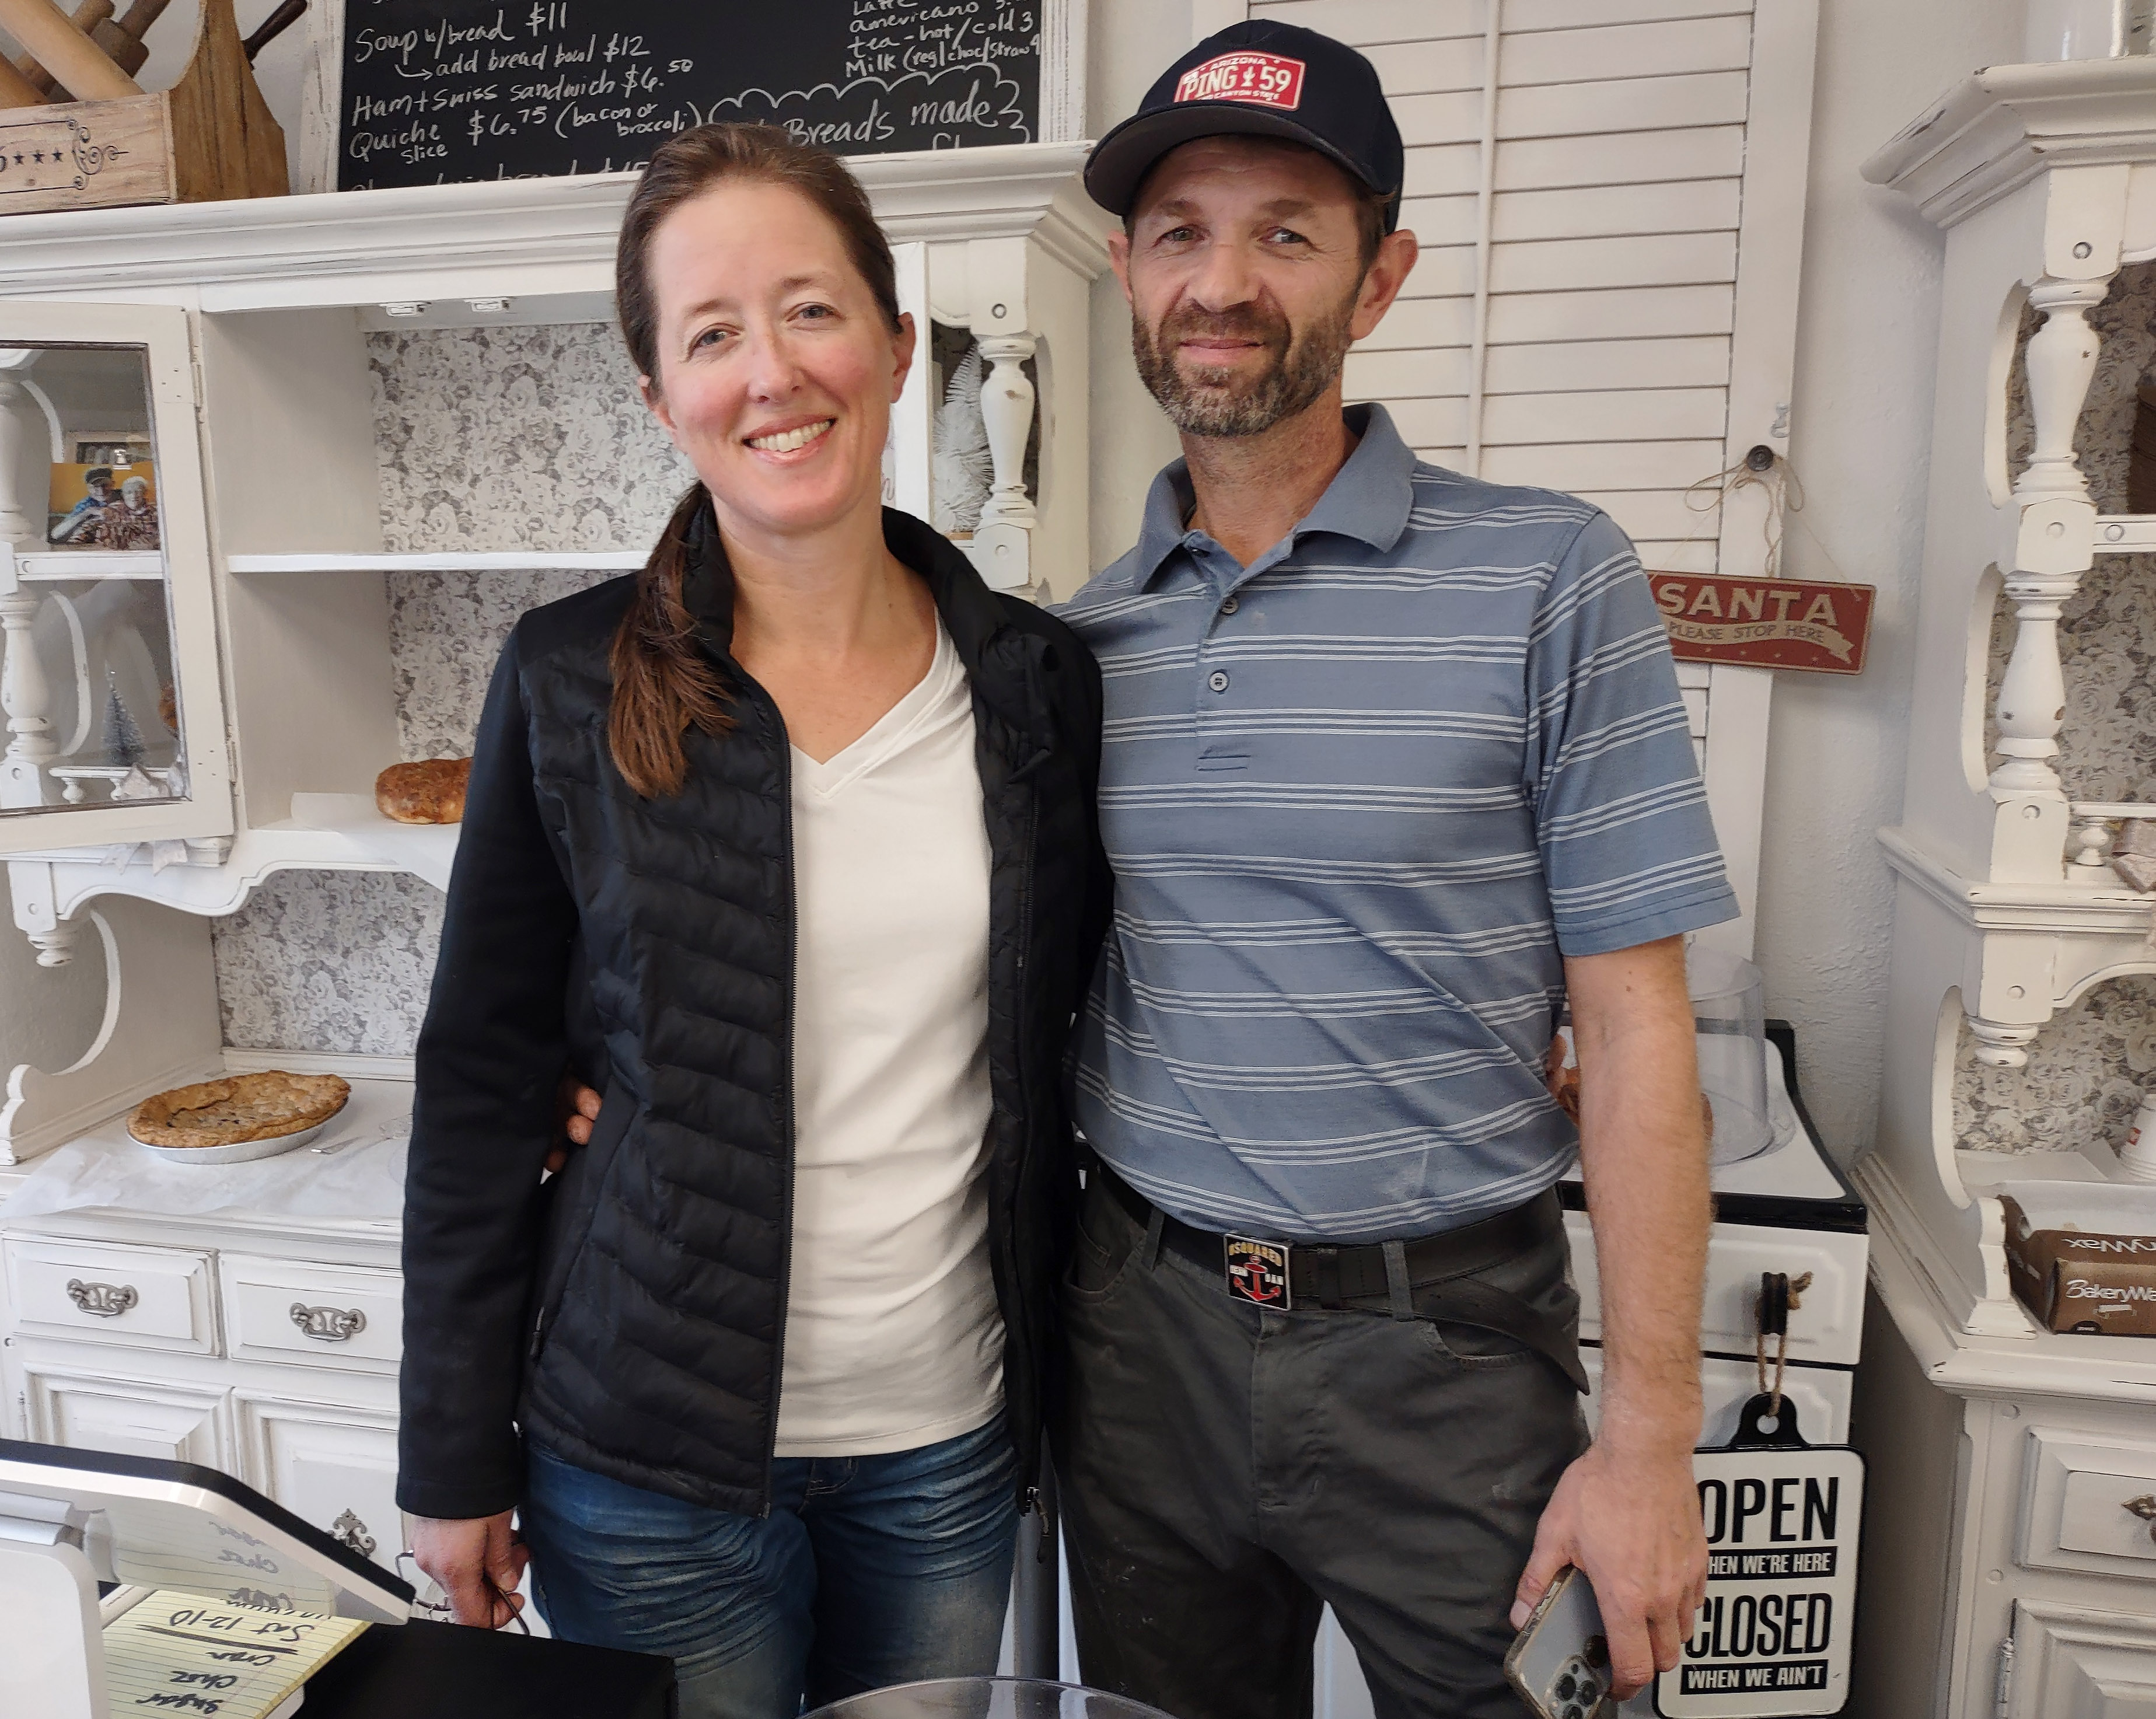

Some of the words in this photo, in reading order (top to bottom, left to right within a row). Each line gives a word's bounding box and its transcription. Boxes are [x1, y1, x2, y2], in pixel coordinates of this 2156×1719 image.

[354, 29, 418, 65] Soup
[526, 2, 567, 36] $11
[847, 36, 900, 58] tea
[1020, 11, 1033, 32] 3
[850, 2, 979, 32] americano
[436, 48, 478, 76] add
[489, 44, 548, 71] bread
[603, 33, 651, 62] $12
[846, 54, 897, 78] Milk
[1210, 57, 1267, 71] ARIZONA
[509, 69, 616, 102] sandwich
[1182, 65, 1239, 102] PING
[1259, 65, 1292, 93] 59
[782, 99, 895, 147] Breads
[910, 79, 999, 127] made
[350, 120, 441, 162] Quiche
[637, 103, 659, 117] or
[400, 144, 448, 164] slice
[1657, 582, 1839, 626] SANTA
[1668, 621, 1724, 640] PLEASE
[1734, 625, 1777, 639] STOP
[1785, 624, 1824, 642] HERE
[1697, 1476, 1839, 1544] OPEN
[1708, 1556, 1739, 1574] HEN
[1742, 1554, 1790, 1574] WE'RE
[1792, 1553, 1832, 1572] HERE
[169, 1610, 243, 1630] 12-10
[1685, 1592, 1832, 1659] CLOSED
[1688, 1669, 1740, 1690] WHEN
[1745, 1668, 1773, 1688] WE
[1777, 1665, 1824, 1686] AIN'T
